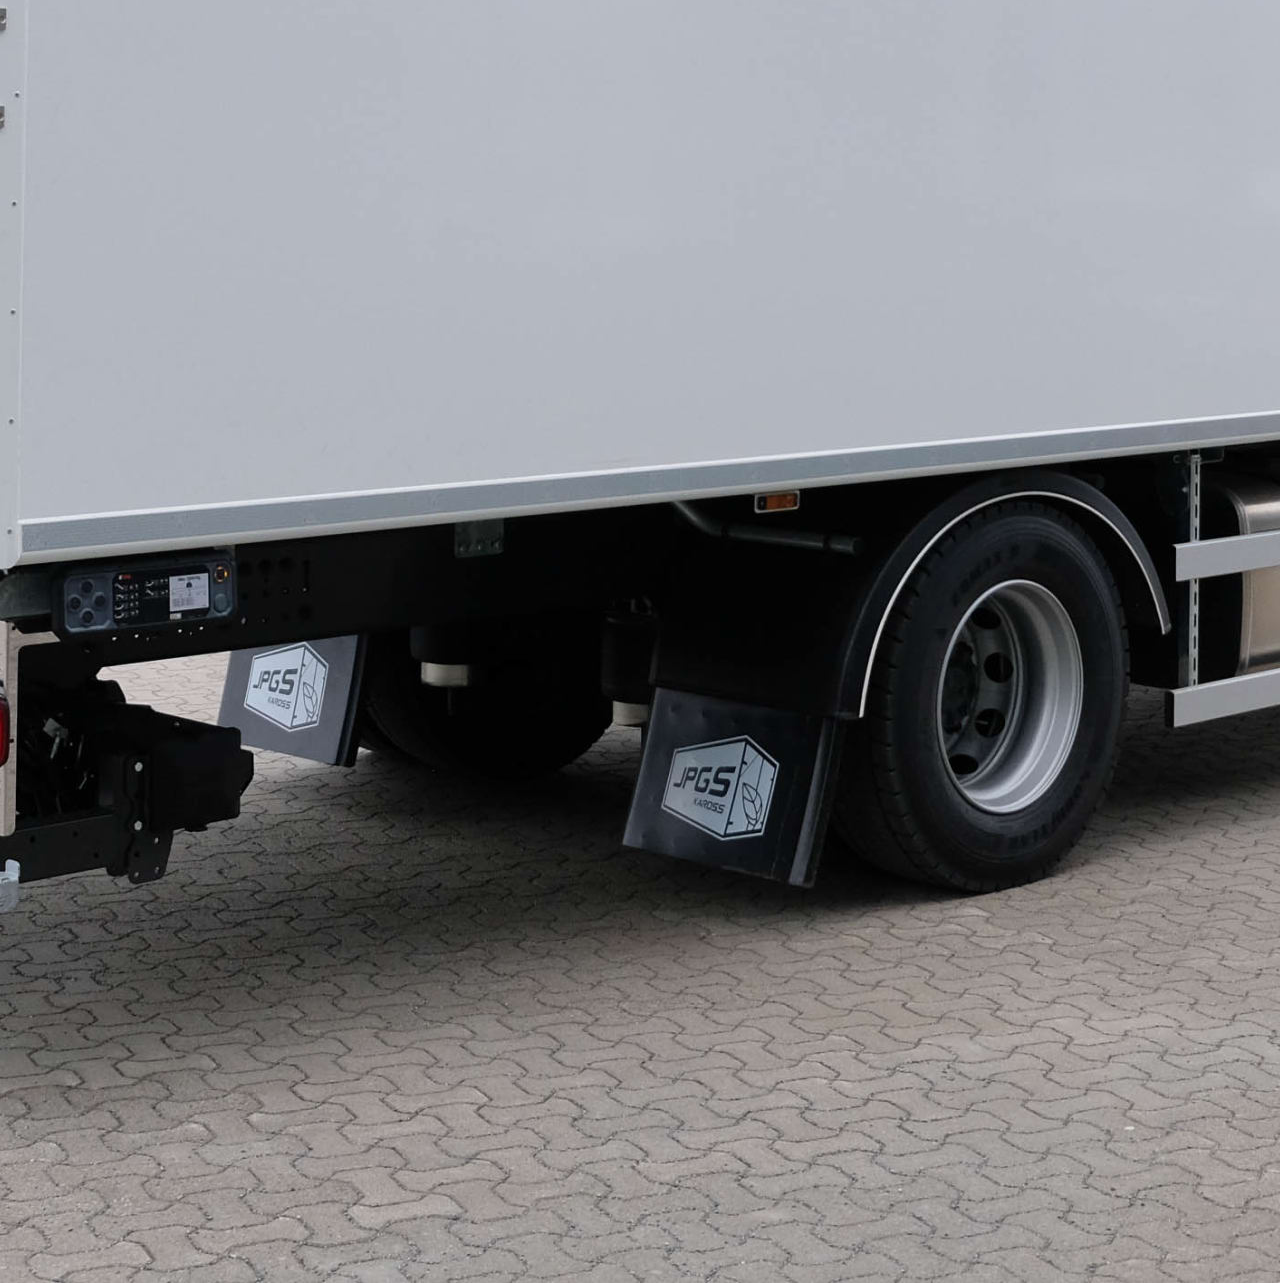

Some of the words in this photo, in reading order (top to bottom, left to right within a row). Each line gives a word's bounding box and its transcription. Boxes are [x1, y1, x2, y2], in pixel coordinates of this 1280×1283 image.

[253, 668, 298, 695] JPGS
[673, 766, 737, 797] JPGS
[694, 797, 726, 814] KAROSS
